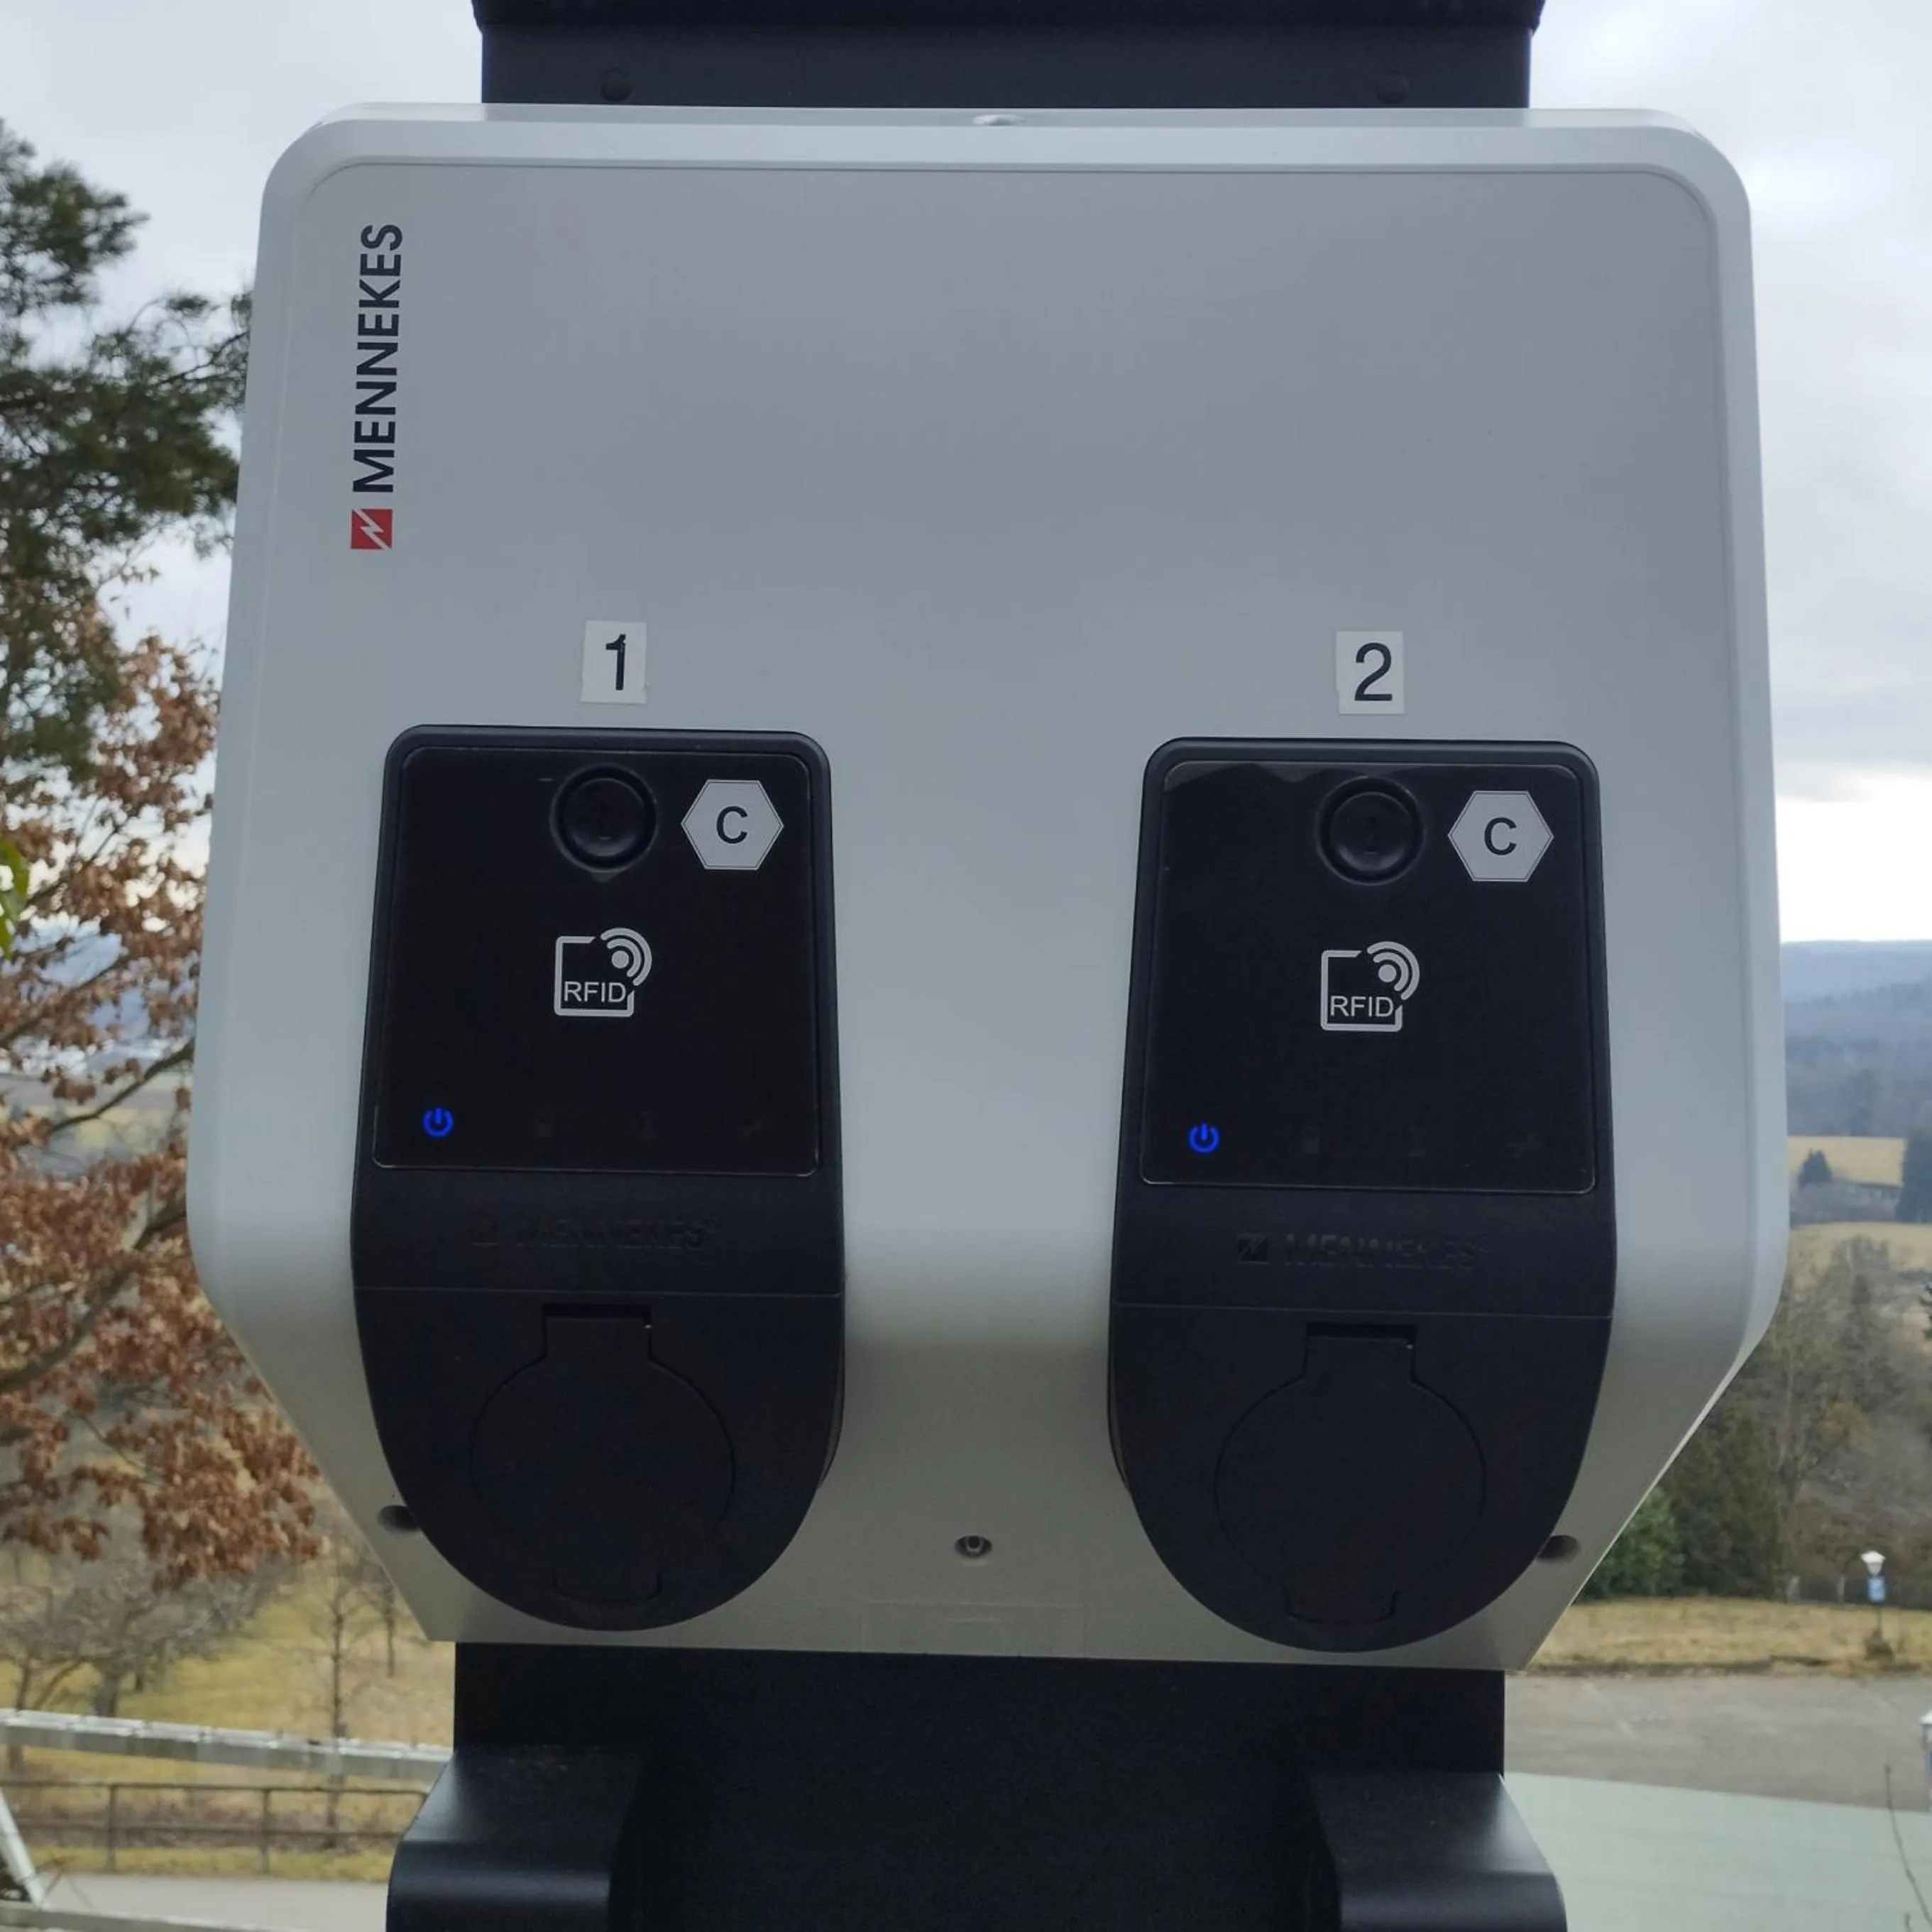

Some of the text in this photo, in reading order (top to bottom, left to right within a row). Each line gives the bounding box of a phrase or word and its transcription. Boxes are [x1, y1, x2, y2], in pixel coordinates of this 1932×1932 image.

[352, 224, 404, 493] MENNEKES
[605, 634, 626, 691] 1
[1354, 642, 1393, 701] 2
[715, 806, 748, 844] C
[1484, 817, 1517, 856] C
[564, 981, 626, 1002] RFID
[1330, 995, 1394, 1016] RFID
